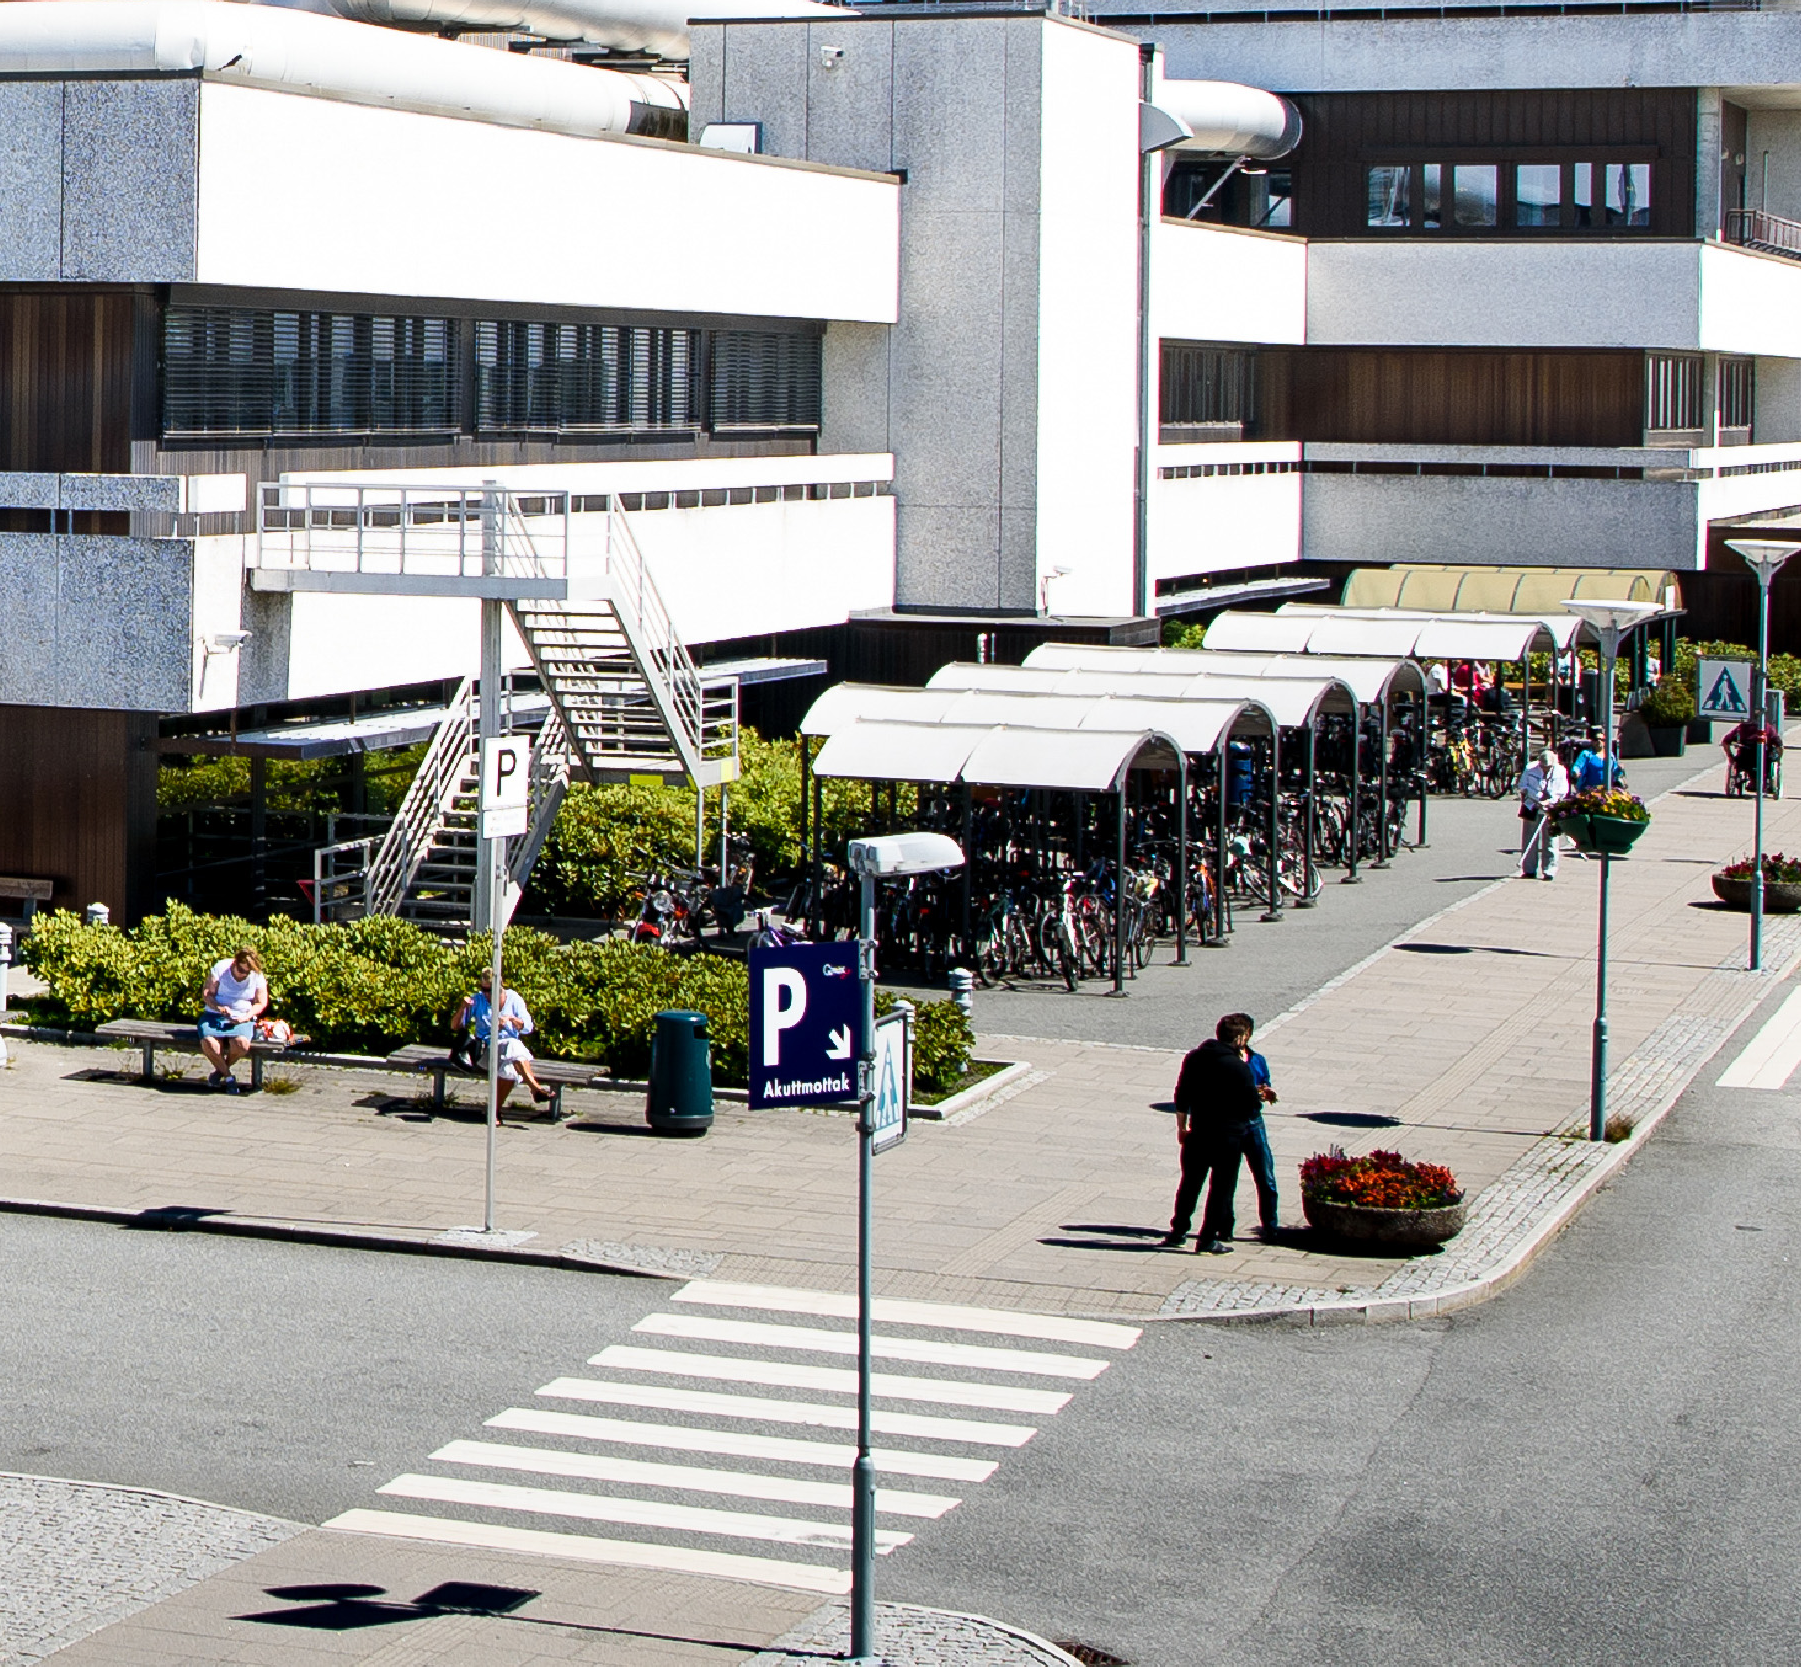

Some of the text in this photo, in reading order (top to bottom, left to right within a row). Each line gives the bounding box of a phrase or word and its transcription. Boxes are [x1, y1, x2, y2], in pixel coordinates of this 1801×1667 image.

[496, 748, 517, 798] P
[763, 967, 808, 1067] P
[763, 1071, 851, 1099] Akuttmottak
